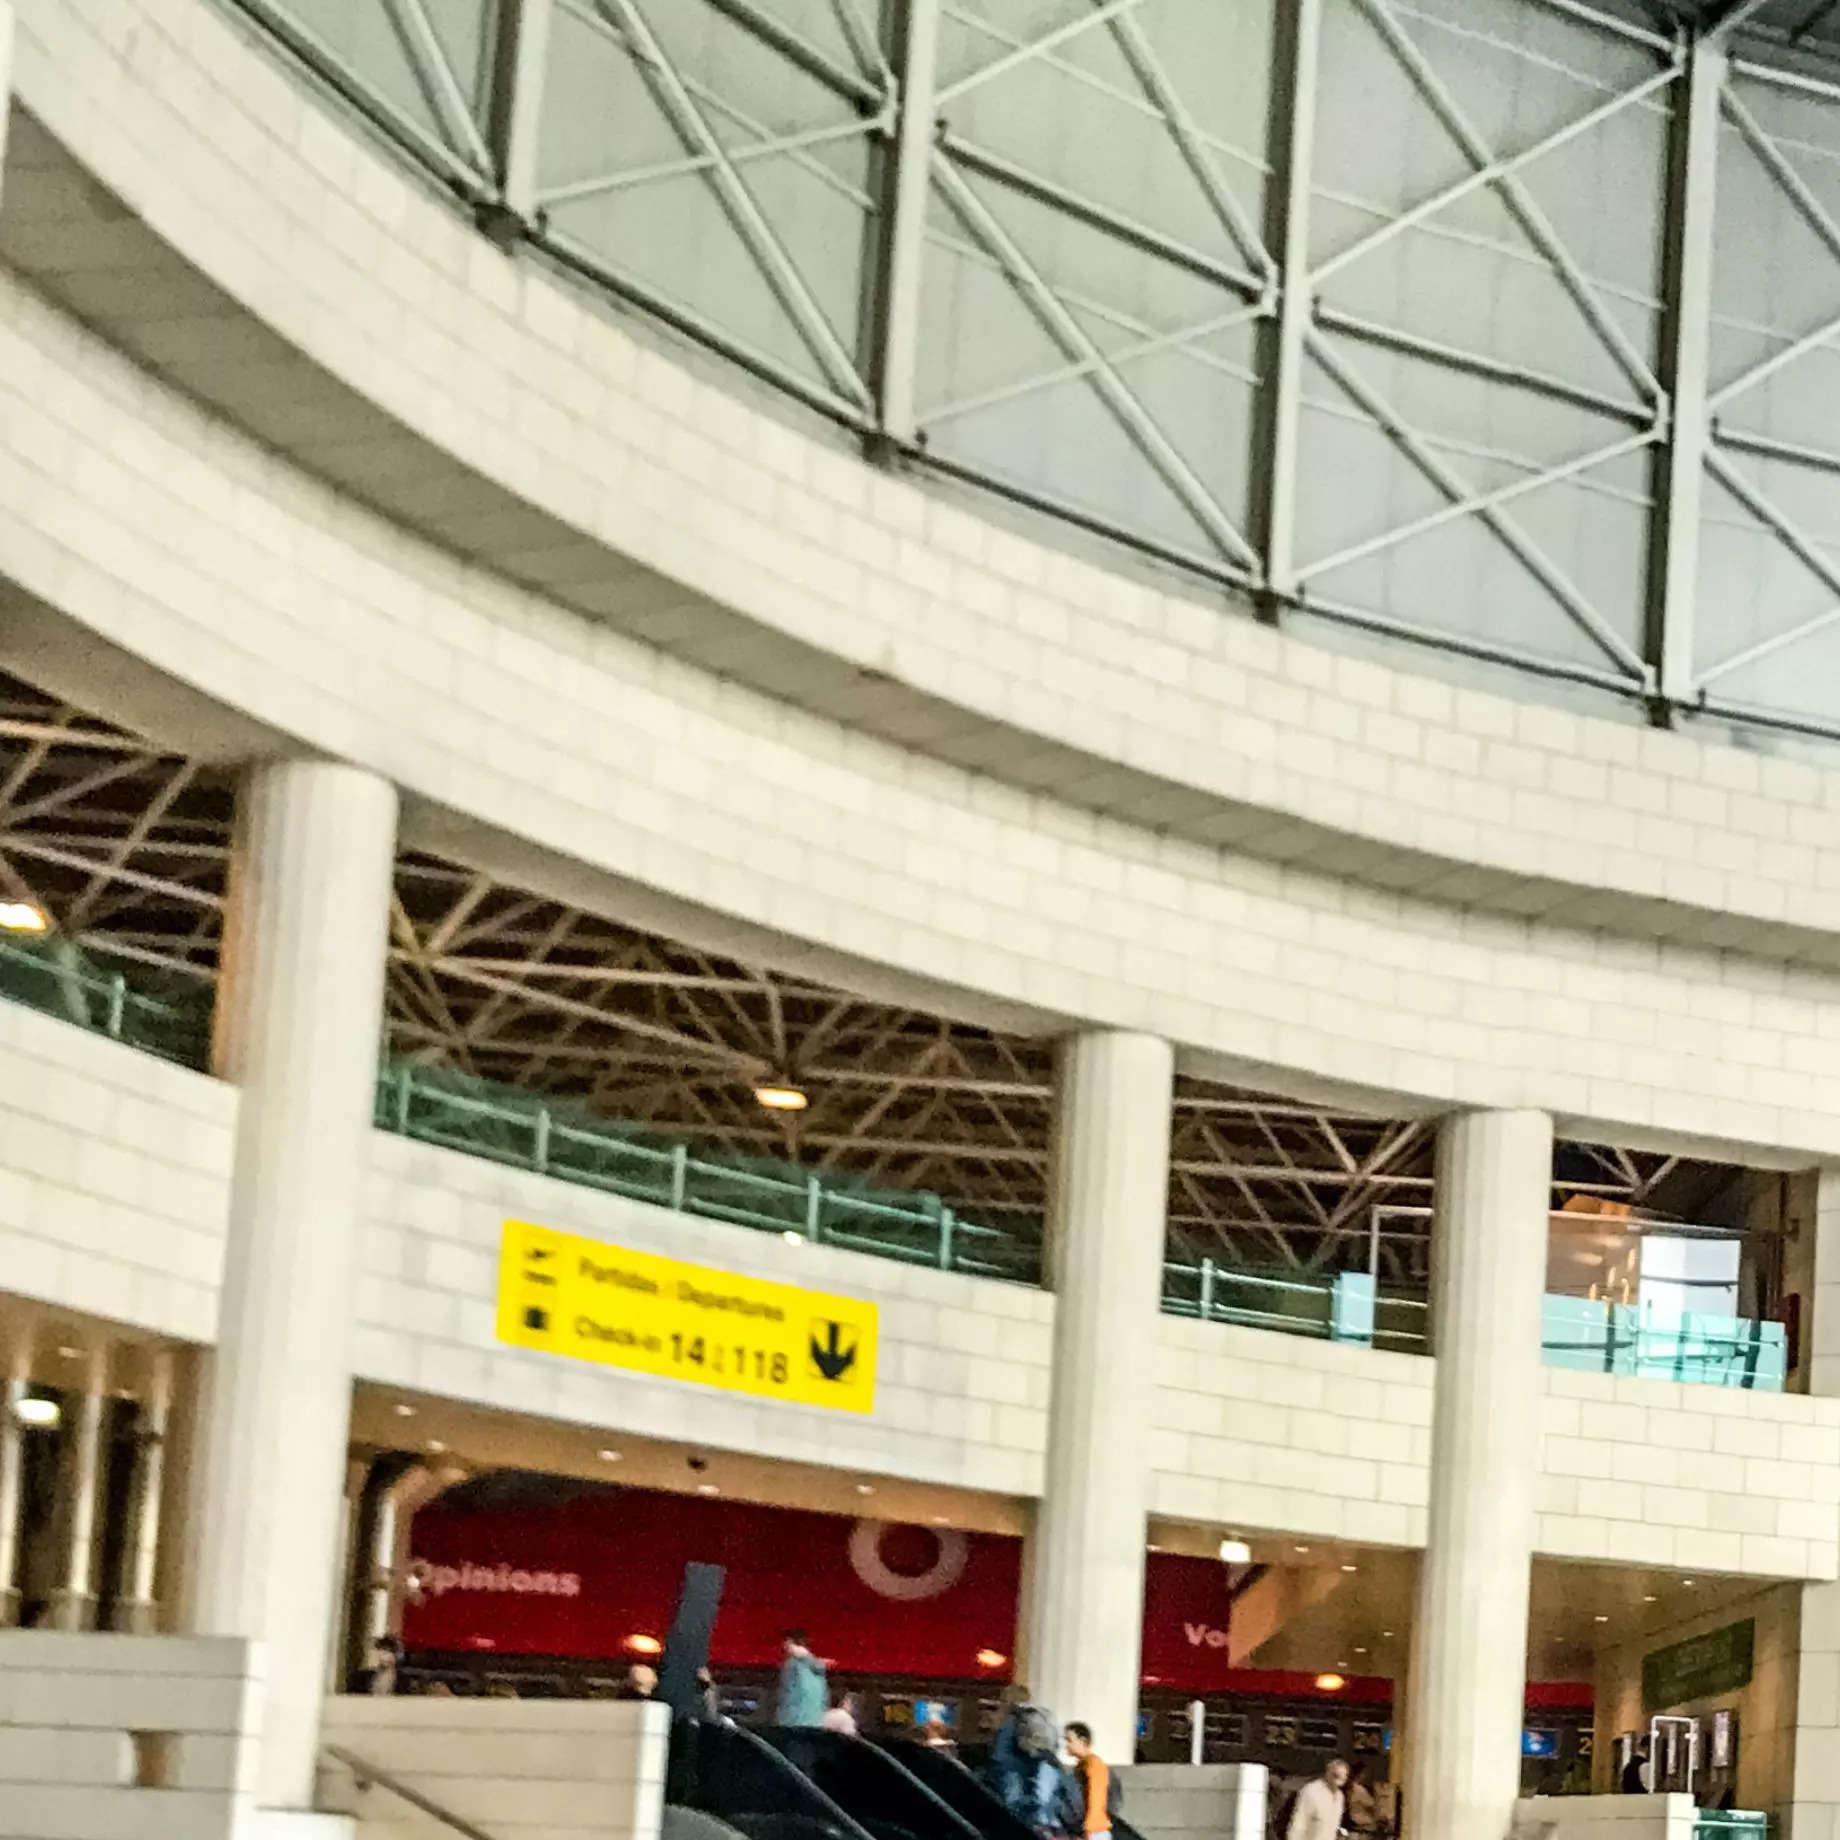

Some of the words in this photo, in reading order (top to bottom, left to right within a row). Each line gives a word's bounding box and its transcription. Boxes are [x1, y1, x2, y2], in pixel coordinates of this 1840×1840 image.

[676, 1280, 786, 1323] Departures
[572, 1315, 662, 1353] Check-in
[669, 1332, 706, 1367] 14
[733, 1345, 790, 1386] 118
[407, 1557, 582, 1597] Opinions
